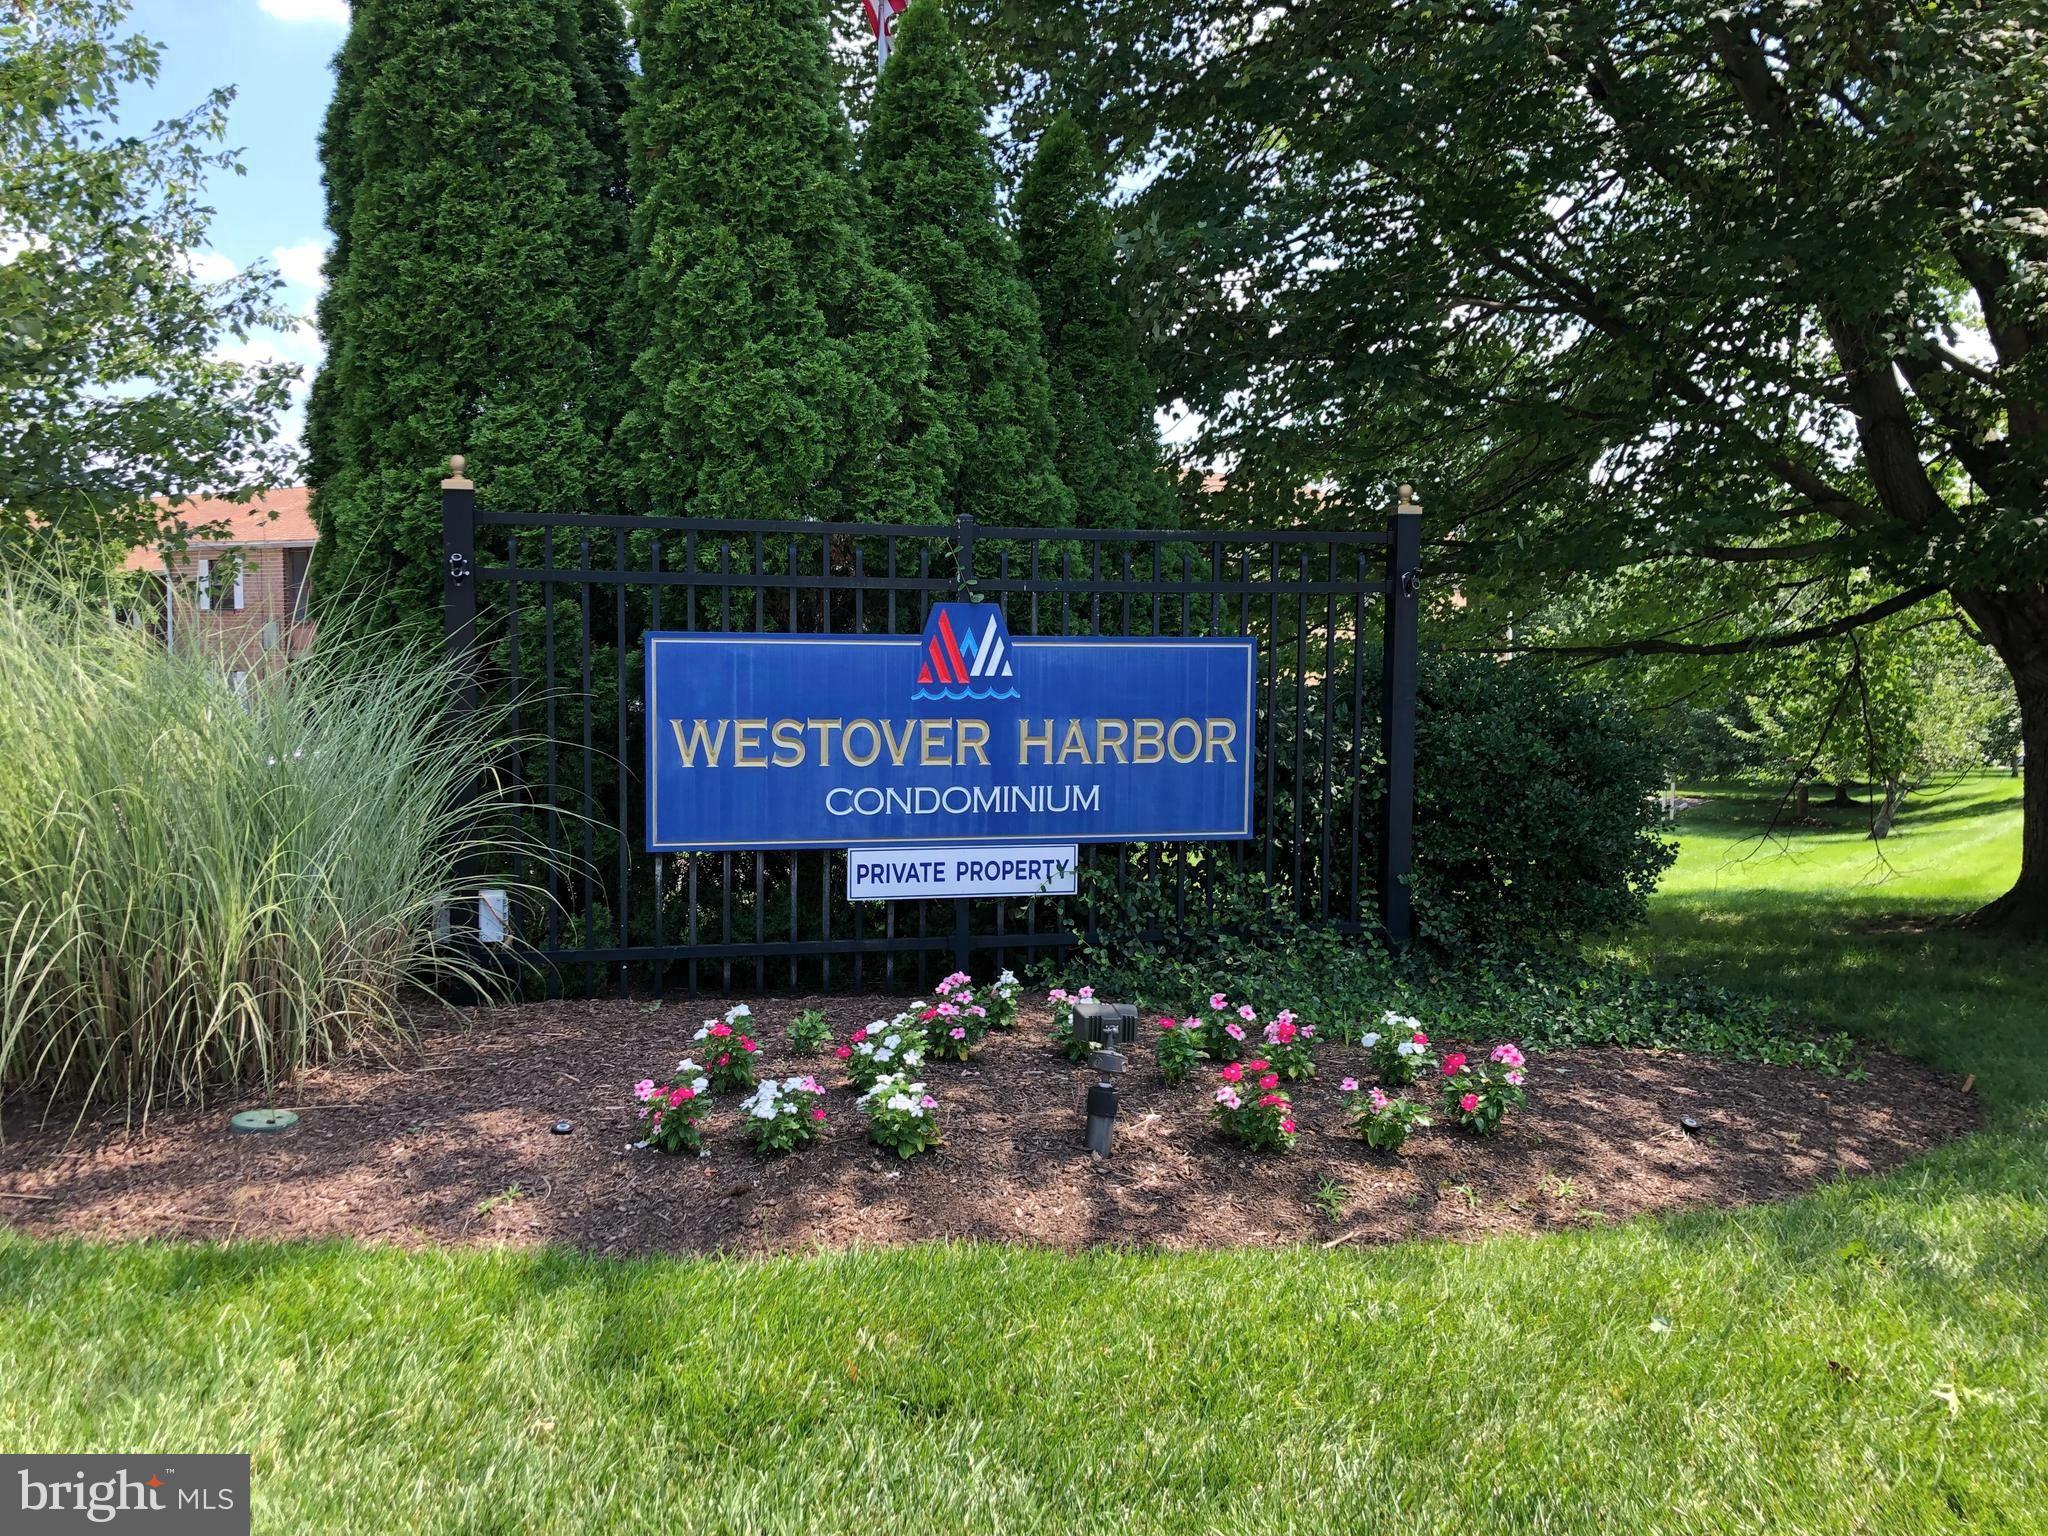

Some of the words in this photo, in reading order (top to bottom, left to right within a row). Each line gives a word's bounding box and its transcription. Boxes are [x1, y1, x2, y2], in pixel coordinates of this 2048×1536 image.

[669, 716, 991, 769] WESTOVER
[1018, 716, 1238, 766] HARBOR
[825, 784, 1101, 816] CONDOMINIUM
[856, 861, 946, 885] PRIVATE
[956, 858, 1070, 882] PROPERTY
